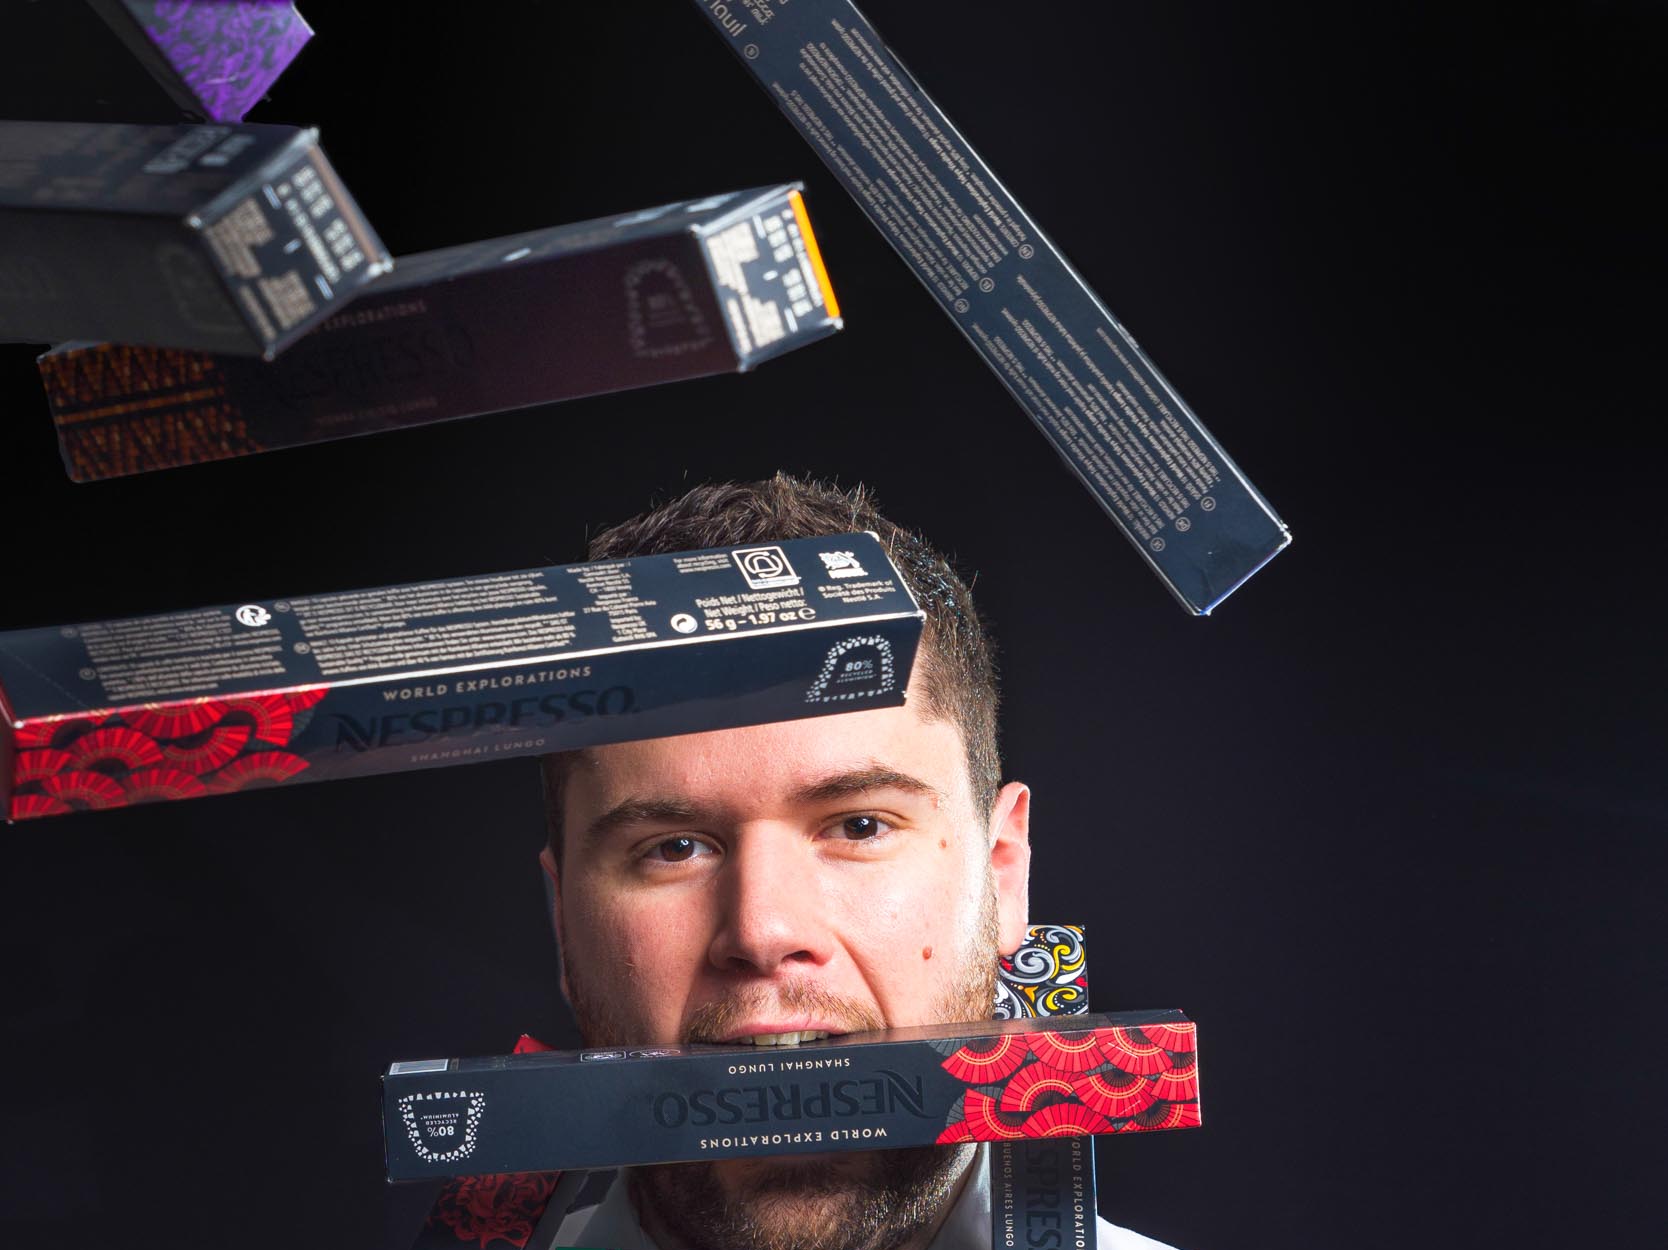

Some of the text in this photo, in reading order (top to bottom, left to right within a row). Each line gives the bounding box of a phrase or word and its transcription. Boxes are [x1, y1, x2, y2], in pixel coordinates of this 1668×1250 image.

[822, 589, 850, 598] Société
[863, 584, 896, 595] Produits
[843, 578, 883, 590] Trademark
[694, 596, 719, 608] Poids
[718, 594, 737, 605] Net
[741, 586, 800, 604] Nettogewicht
[703, 606, 722, 618] Net
[722, 603, 754, 617] Weight
[758, 600, 779, 611] Peso
[704, 611, 797, 630] 56 g 1.97 oz
[844, 659, 873, 672] 80%
[383, 666, 593, 701] WORLD EXPLORATIONS
[325, 686, 634, 753] NESPRESSO
[410, 737, 546, 762] SHANGHAI LUNGO
[727, 1058, 849, 1075] SHANGHAI LUNGO
[652, 1067, 936, 1132] NESPRESSO
[426, 1125, 455, 1136] 80%
[698, 1126, 887, 1148] WORLD EXPLORATIONS
[1001, 1141, 1015, 1247] BUENOS AIRES LUNGO
